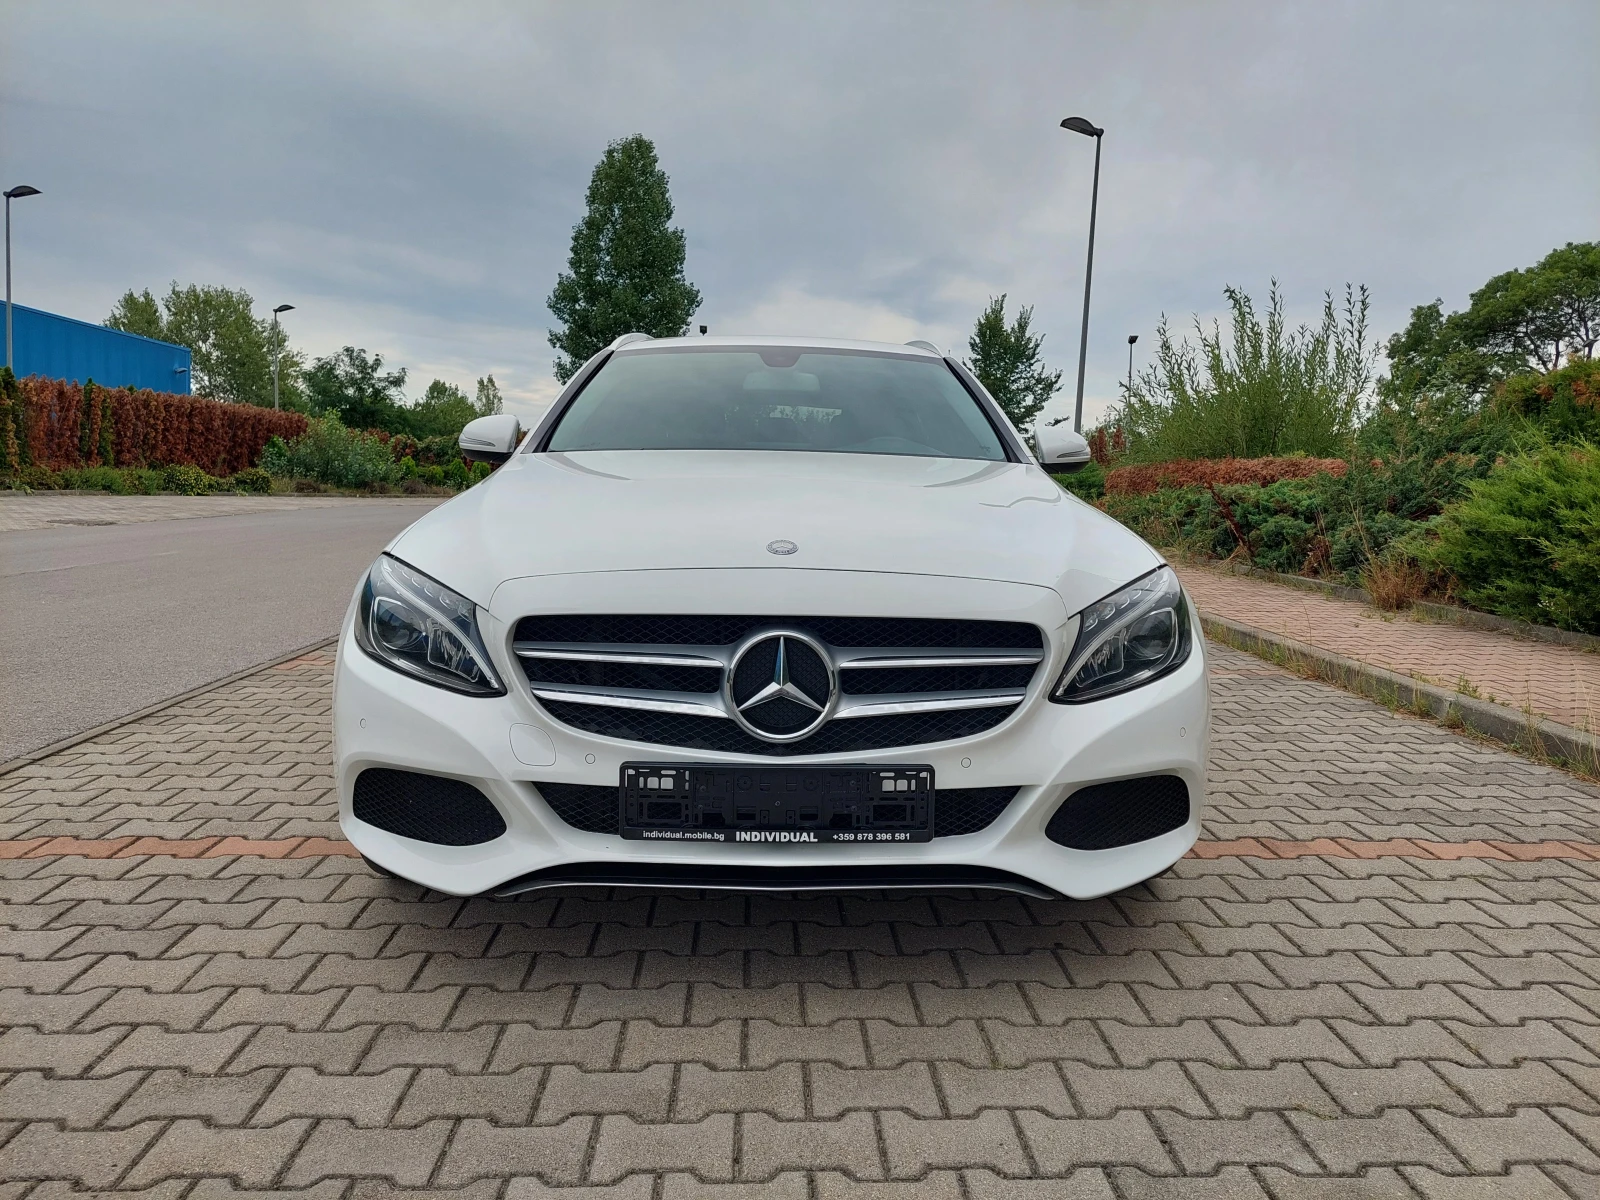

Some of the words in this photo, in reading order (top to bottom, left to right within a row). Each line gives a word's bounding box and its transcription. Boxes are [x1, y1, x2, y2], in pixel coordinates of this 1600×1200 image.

[643, 831, 725, 841] individual.mobile.bg
[736, 832, 818, 842] INDIVIDUAL
[832, 833, 855, 841] +359
[857, 833, 873, 841] 878
[876, 833, 892, 841] 396
[894, 833, 910, 841] 581
